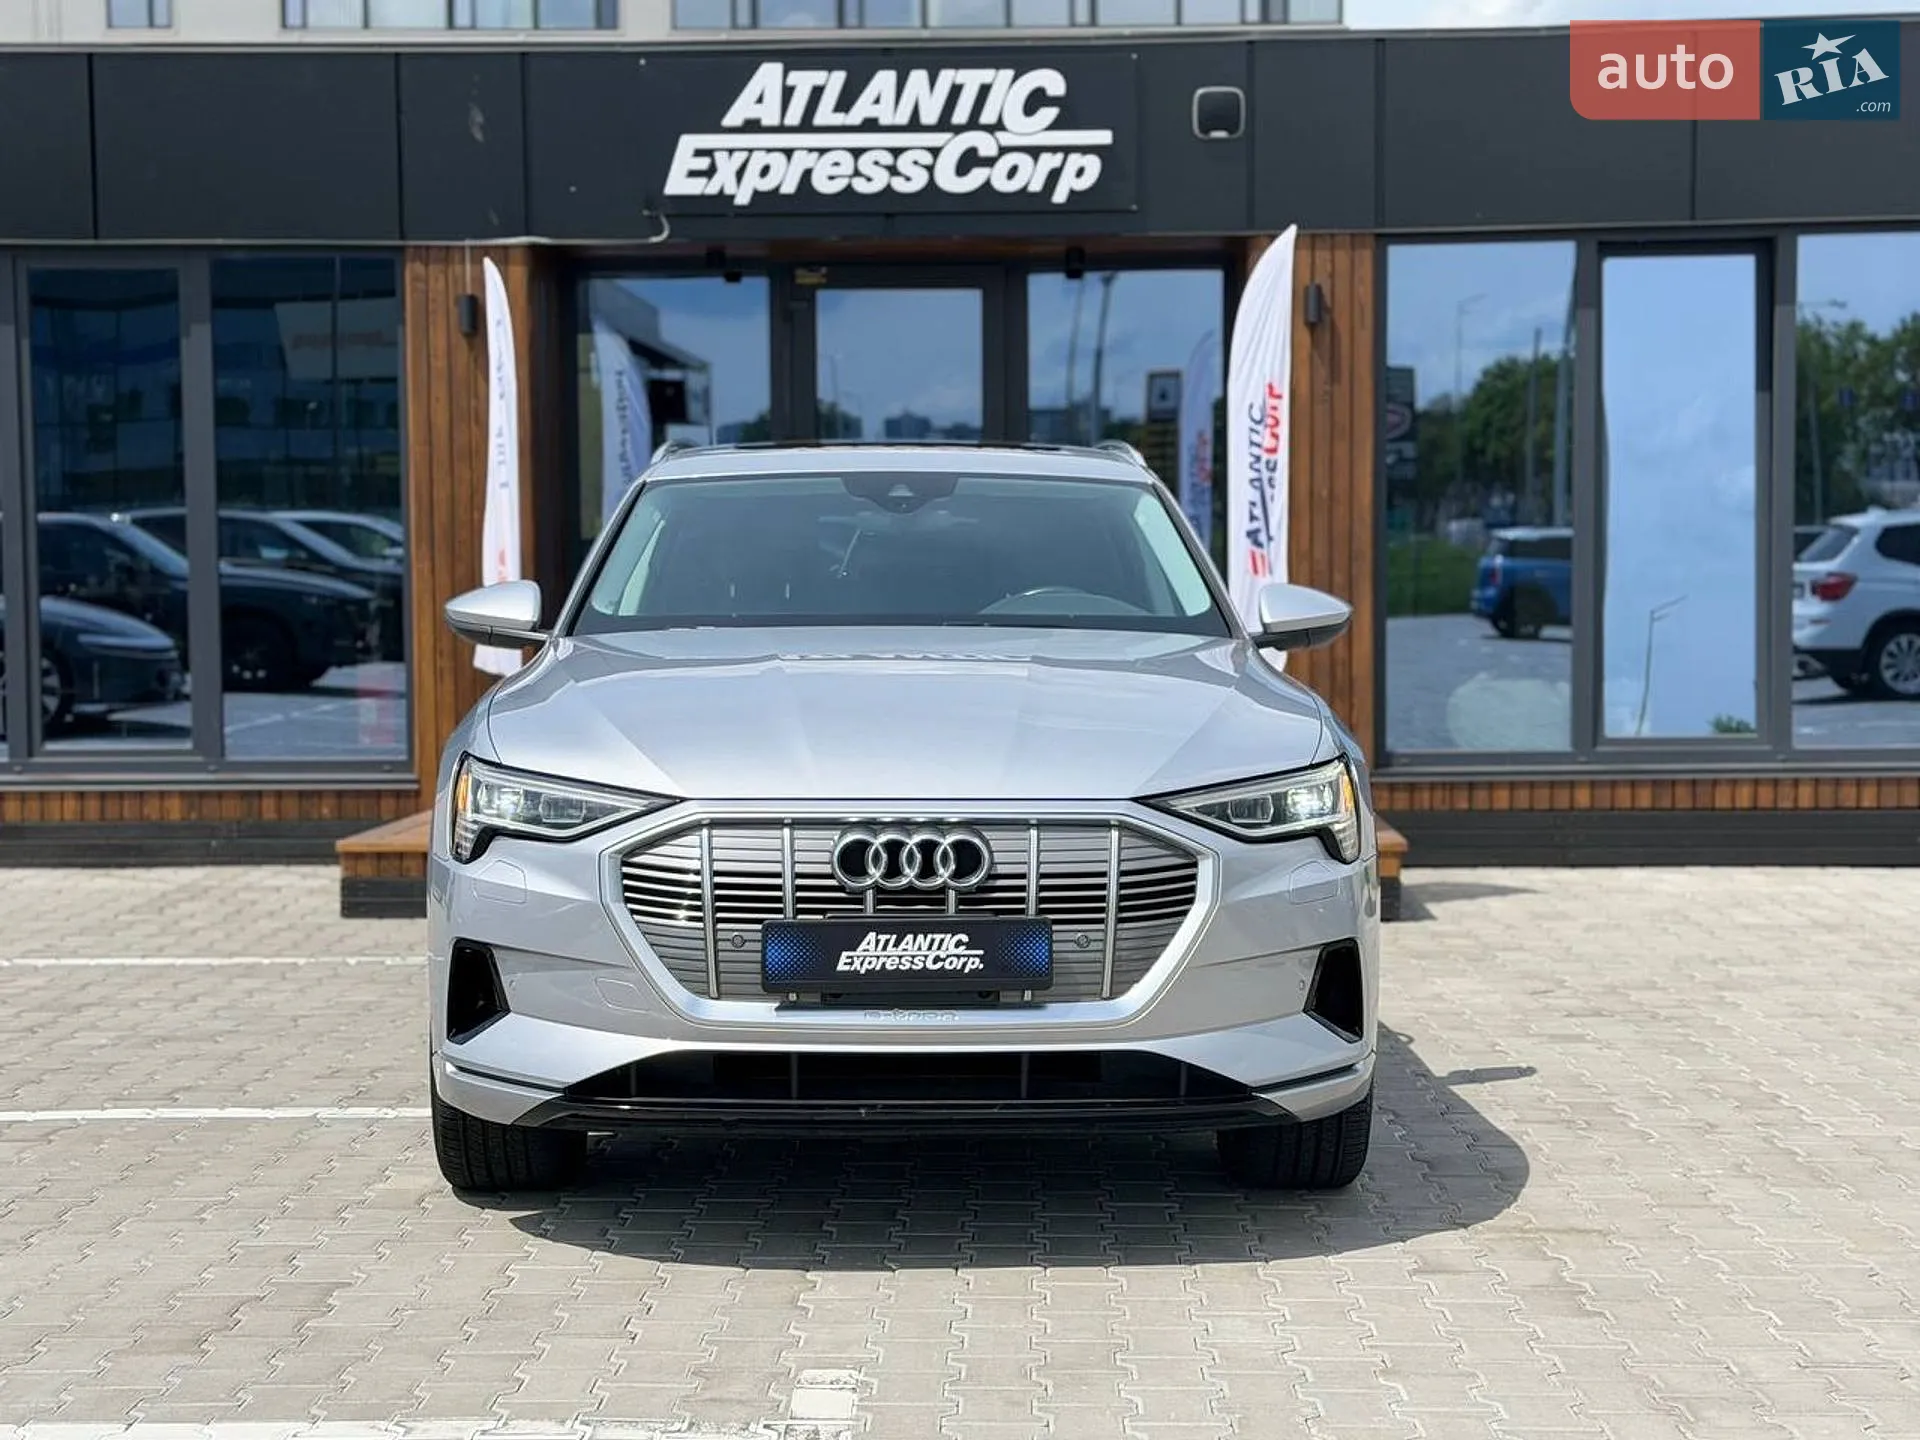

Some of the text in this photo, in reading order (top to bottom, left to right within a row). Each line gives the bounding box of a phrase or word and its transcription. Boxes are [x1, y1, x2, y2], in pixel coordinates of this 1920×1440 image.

[721, 61, 1067, 134] ATLANTIC
[663, 130, 1103, 206] ExpressCorp
[856, 931, 969, 953] ATLANTIC
